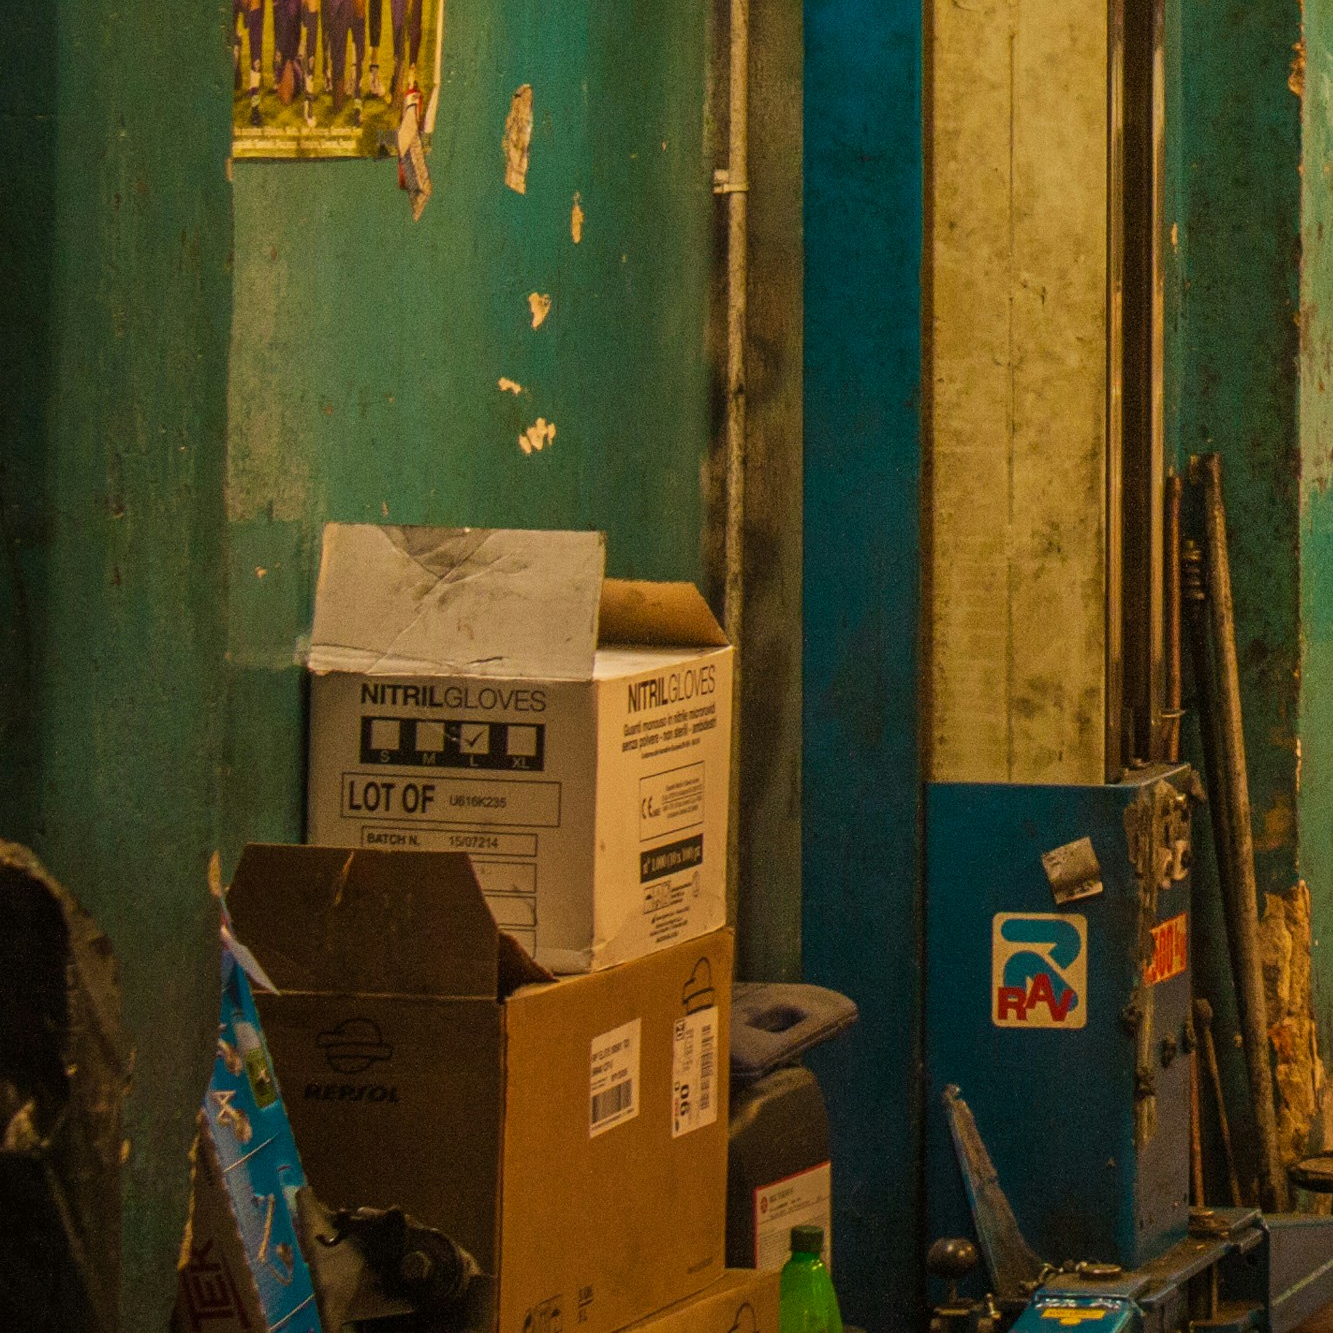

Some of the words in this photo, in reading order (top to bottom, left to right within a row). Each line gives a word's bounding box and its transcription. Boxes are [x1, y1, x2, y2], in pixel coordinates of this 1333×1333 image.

[360, 682, 547, 712] NITRILGLOVES
[628, 665, 716, 714] NITRILGLOVES
[380, 751, 391, 763] S
[422, 754, 436, 765] M
[469, 757, 478, 767] L
[512, 757, 530, 769] XL
[350, 781, 396, 812] LOT
[402, 783, 436, 814] OF
[366, 832, 406, 845] BATCH
[998, 973, 1074, 1022] RAV
